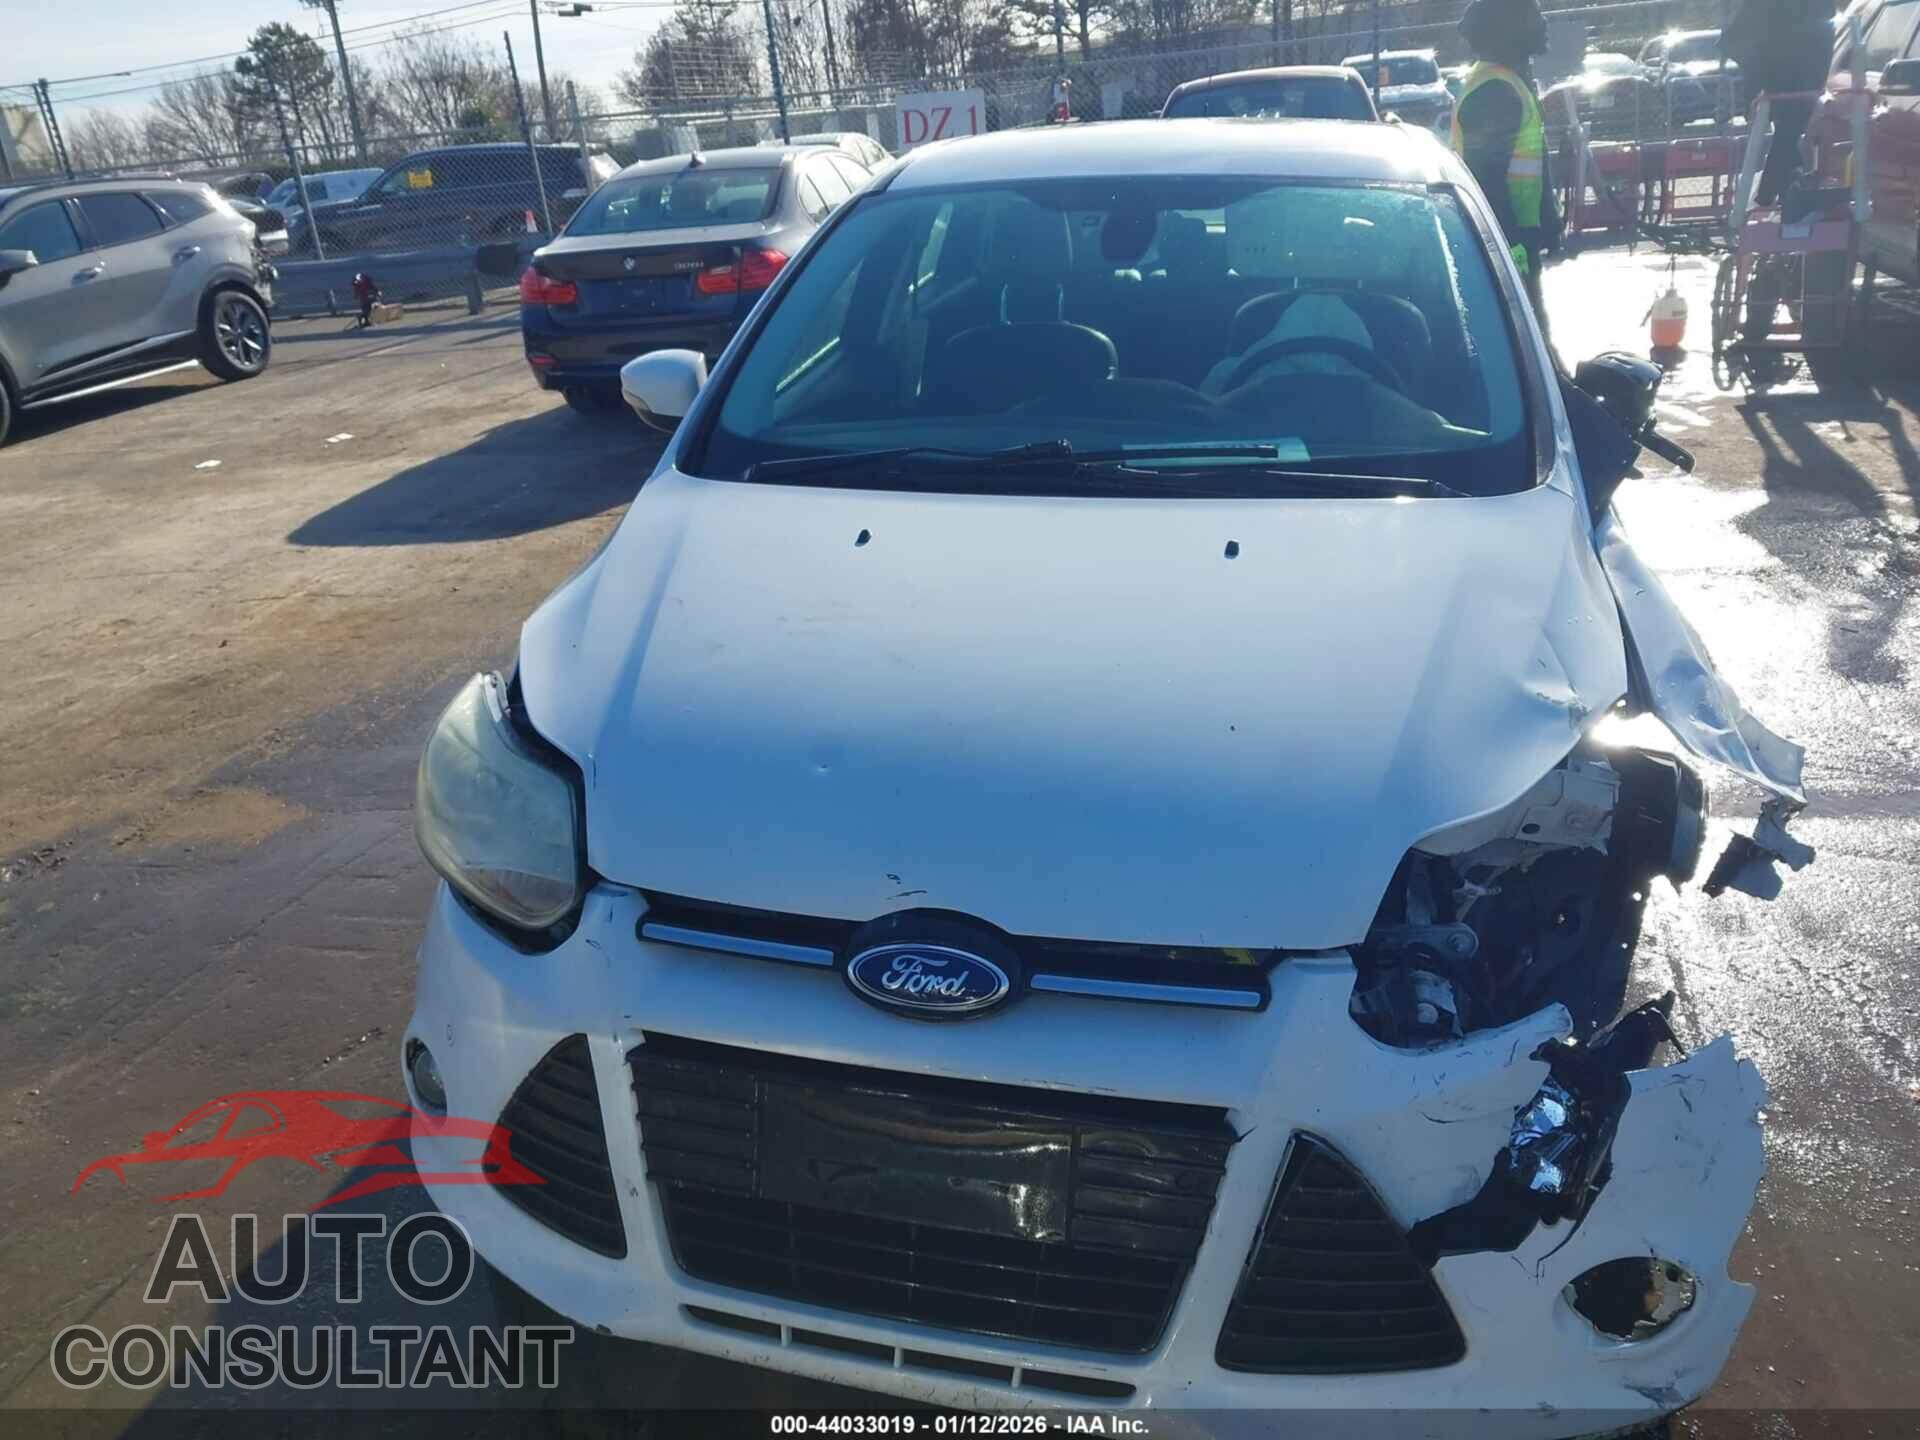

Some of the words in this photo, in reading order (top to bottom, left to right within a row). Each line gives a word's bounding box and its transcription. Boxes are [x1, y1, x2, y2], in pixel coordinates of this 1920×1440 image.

[901, 106, 954, 144] DZ
[966, 104, 978, 135] 1
[881, 954, 969, 996] Ford
